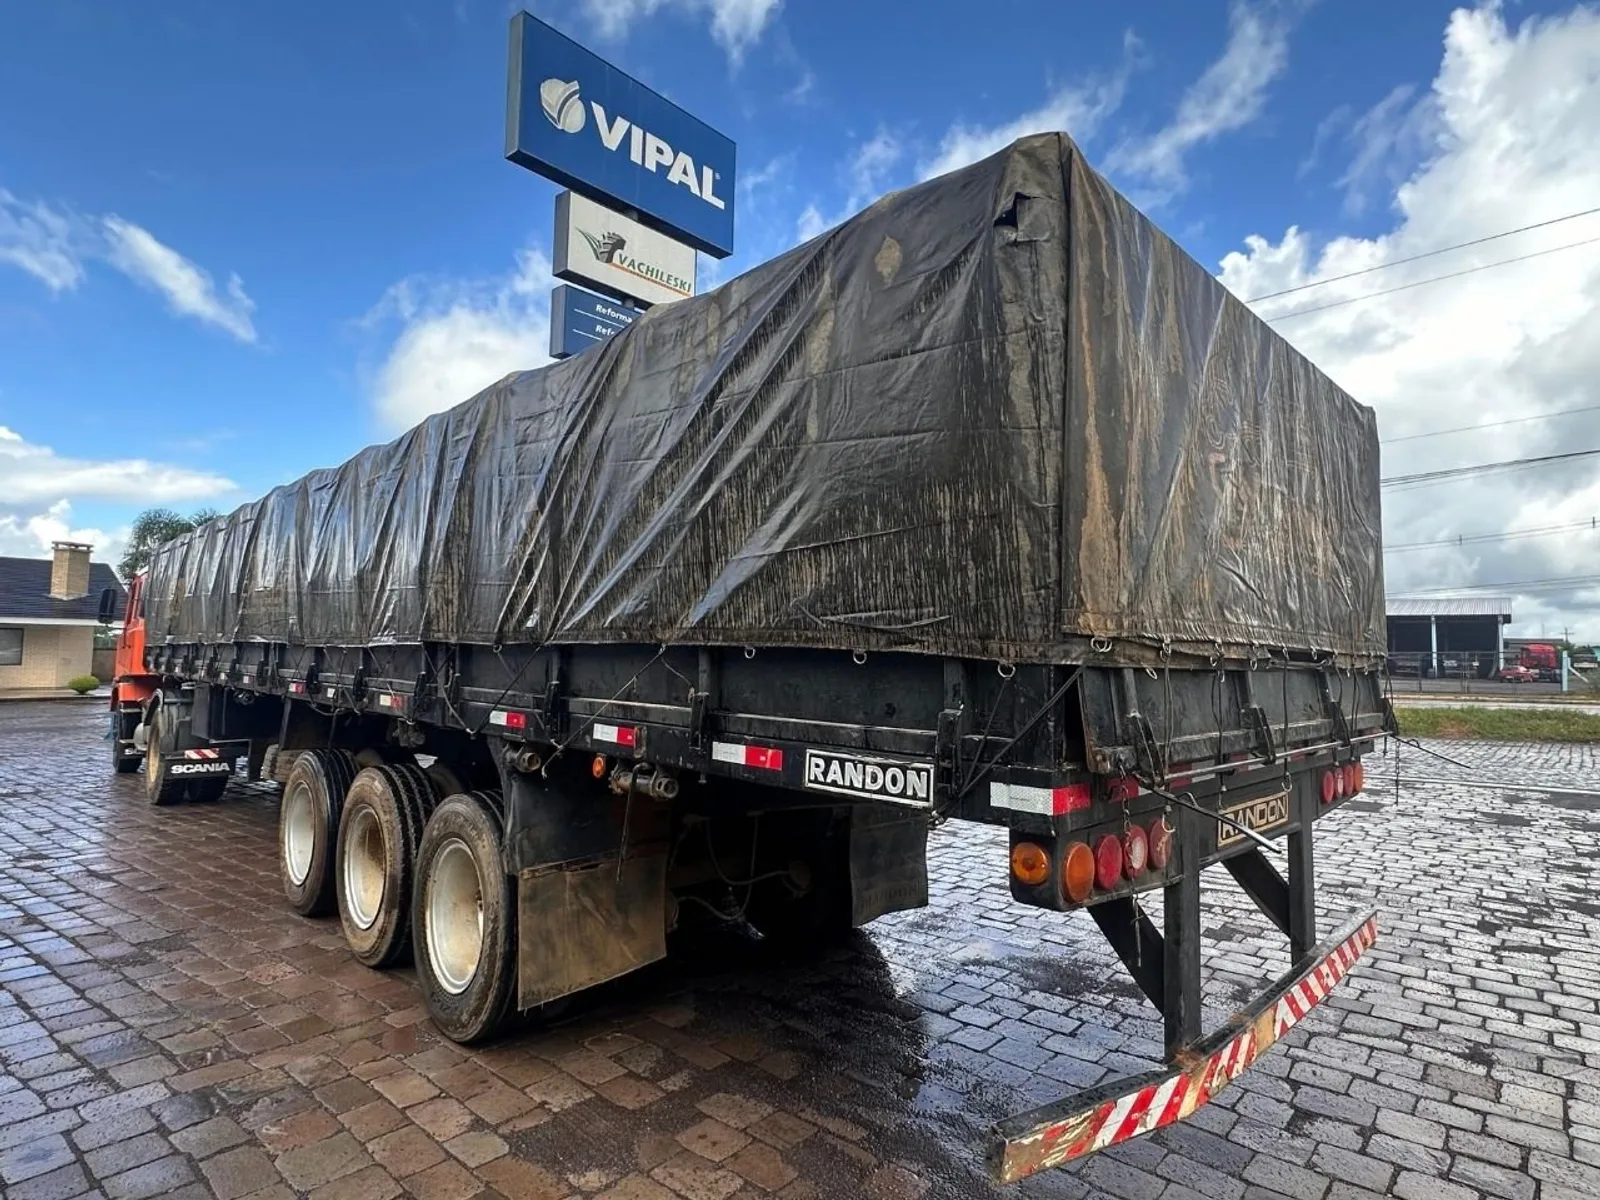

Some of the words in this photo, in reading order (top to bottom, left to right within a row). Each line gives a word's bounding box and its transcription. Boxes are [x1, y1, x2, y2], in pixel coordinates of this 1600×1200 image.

[591, 101, 725, 210] VIPAL
[619, 253, 692, 293] VACHILESKI
[171, 762, 230, 774] SCANIA
[809, 756, 928, 798] RANDON
